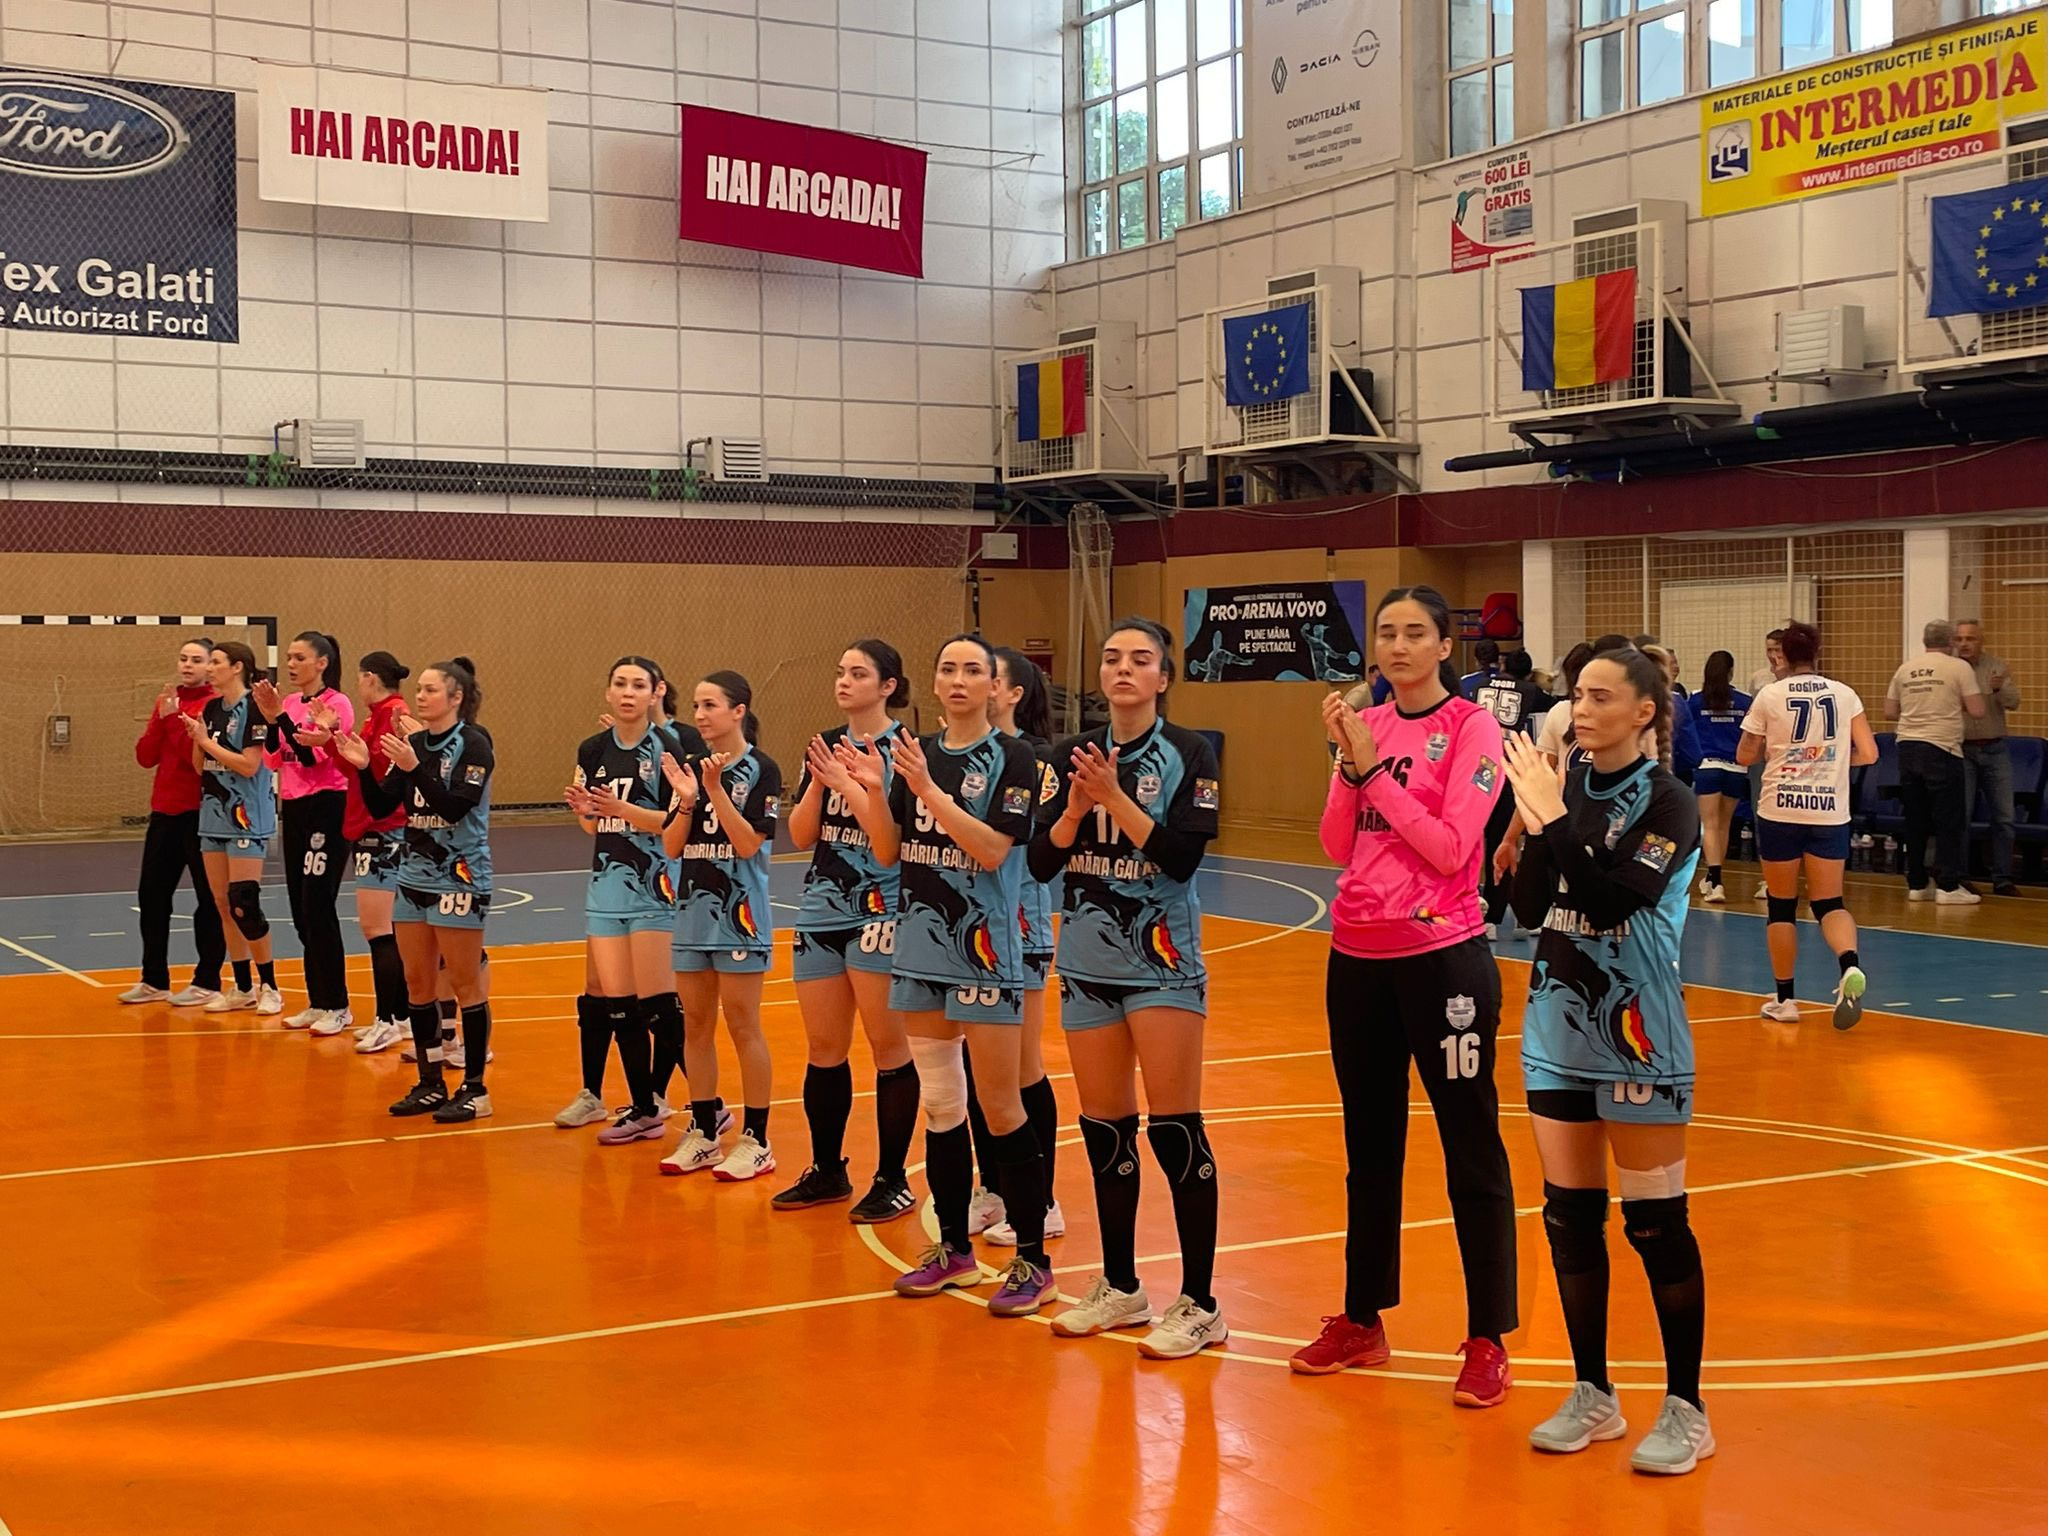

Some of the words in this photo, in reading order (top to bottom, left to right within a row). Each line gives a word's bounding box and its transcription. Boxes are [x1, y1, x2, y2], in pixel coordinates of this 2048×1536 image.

[1300, 54, 1341, 73] DACIA
[1713, 82, 1793, 113] MATERIALE
[1797, 76, 1817, 93] DE
[1821, 47, 1932, 86] CONSTRUCȚIE
[1938, 41, 1954, 60] ȘI
[1959, 20, 2038, 53] FINISAJE
[1760, 51, 2038, 152] INTERMEDIA
[0, 92, 126, 160] Ford
[291, 107, 352, 160] HAI
[362, 116, 520, 176] ARCADA!
[1815, 130, 1889, 160] Meșterul
[1892, 123, 1934, 143] casei
[1938, 112, 1972, 133] tale
[1519, 150, 1529, 160] DE
[1801, 138, 1984, 189] www.intermedia-co.ro
[1485, 166, 1507, 185] 600
[1511, 160, 1531, 179] LEI
[706, 155, 760, 206] HAI
[767, 166, 903, 230] ARCADA!
[1484, 188, 1531, 212] GRATIS
[77, 257, 214, 311] Galați
[13, 302, 139, 331] Autorizat
[147, 310, 209, 335] Ford
[1287, 600, 1327, 618] VOYO
[1239, 642, 1251, 653] PE
[1251, 641, 1296, 653] SPECTACOL!
[1244, 628, 1267, 640] PUNE
[1267, 625, 1290, 639] MÂNA
[1910, 668, 1934, 679] SCM
[1477, 687, 1522, 726] 55
[1786, 694, 1838, 744] 71
[608, 777, 634, 803] 17
[1776, 793, 1836, 811] CRAIOVA
[303, 851, 328, 876] 96
[438, 892, 473, 917] 89
[859, 920, 896, 955] 88
[1440, 1032, 1481, 1079] 16
